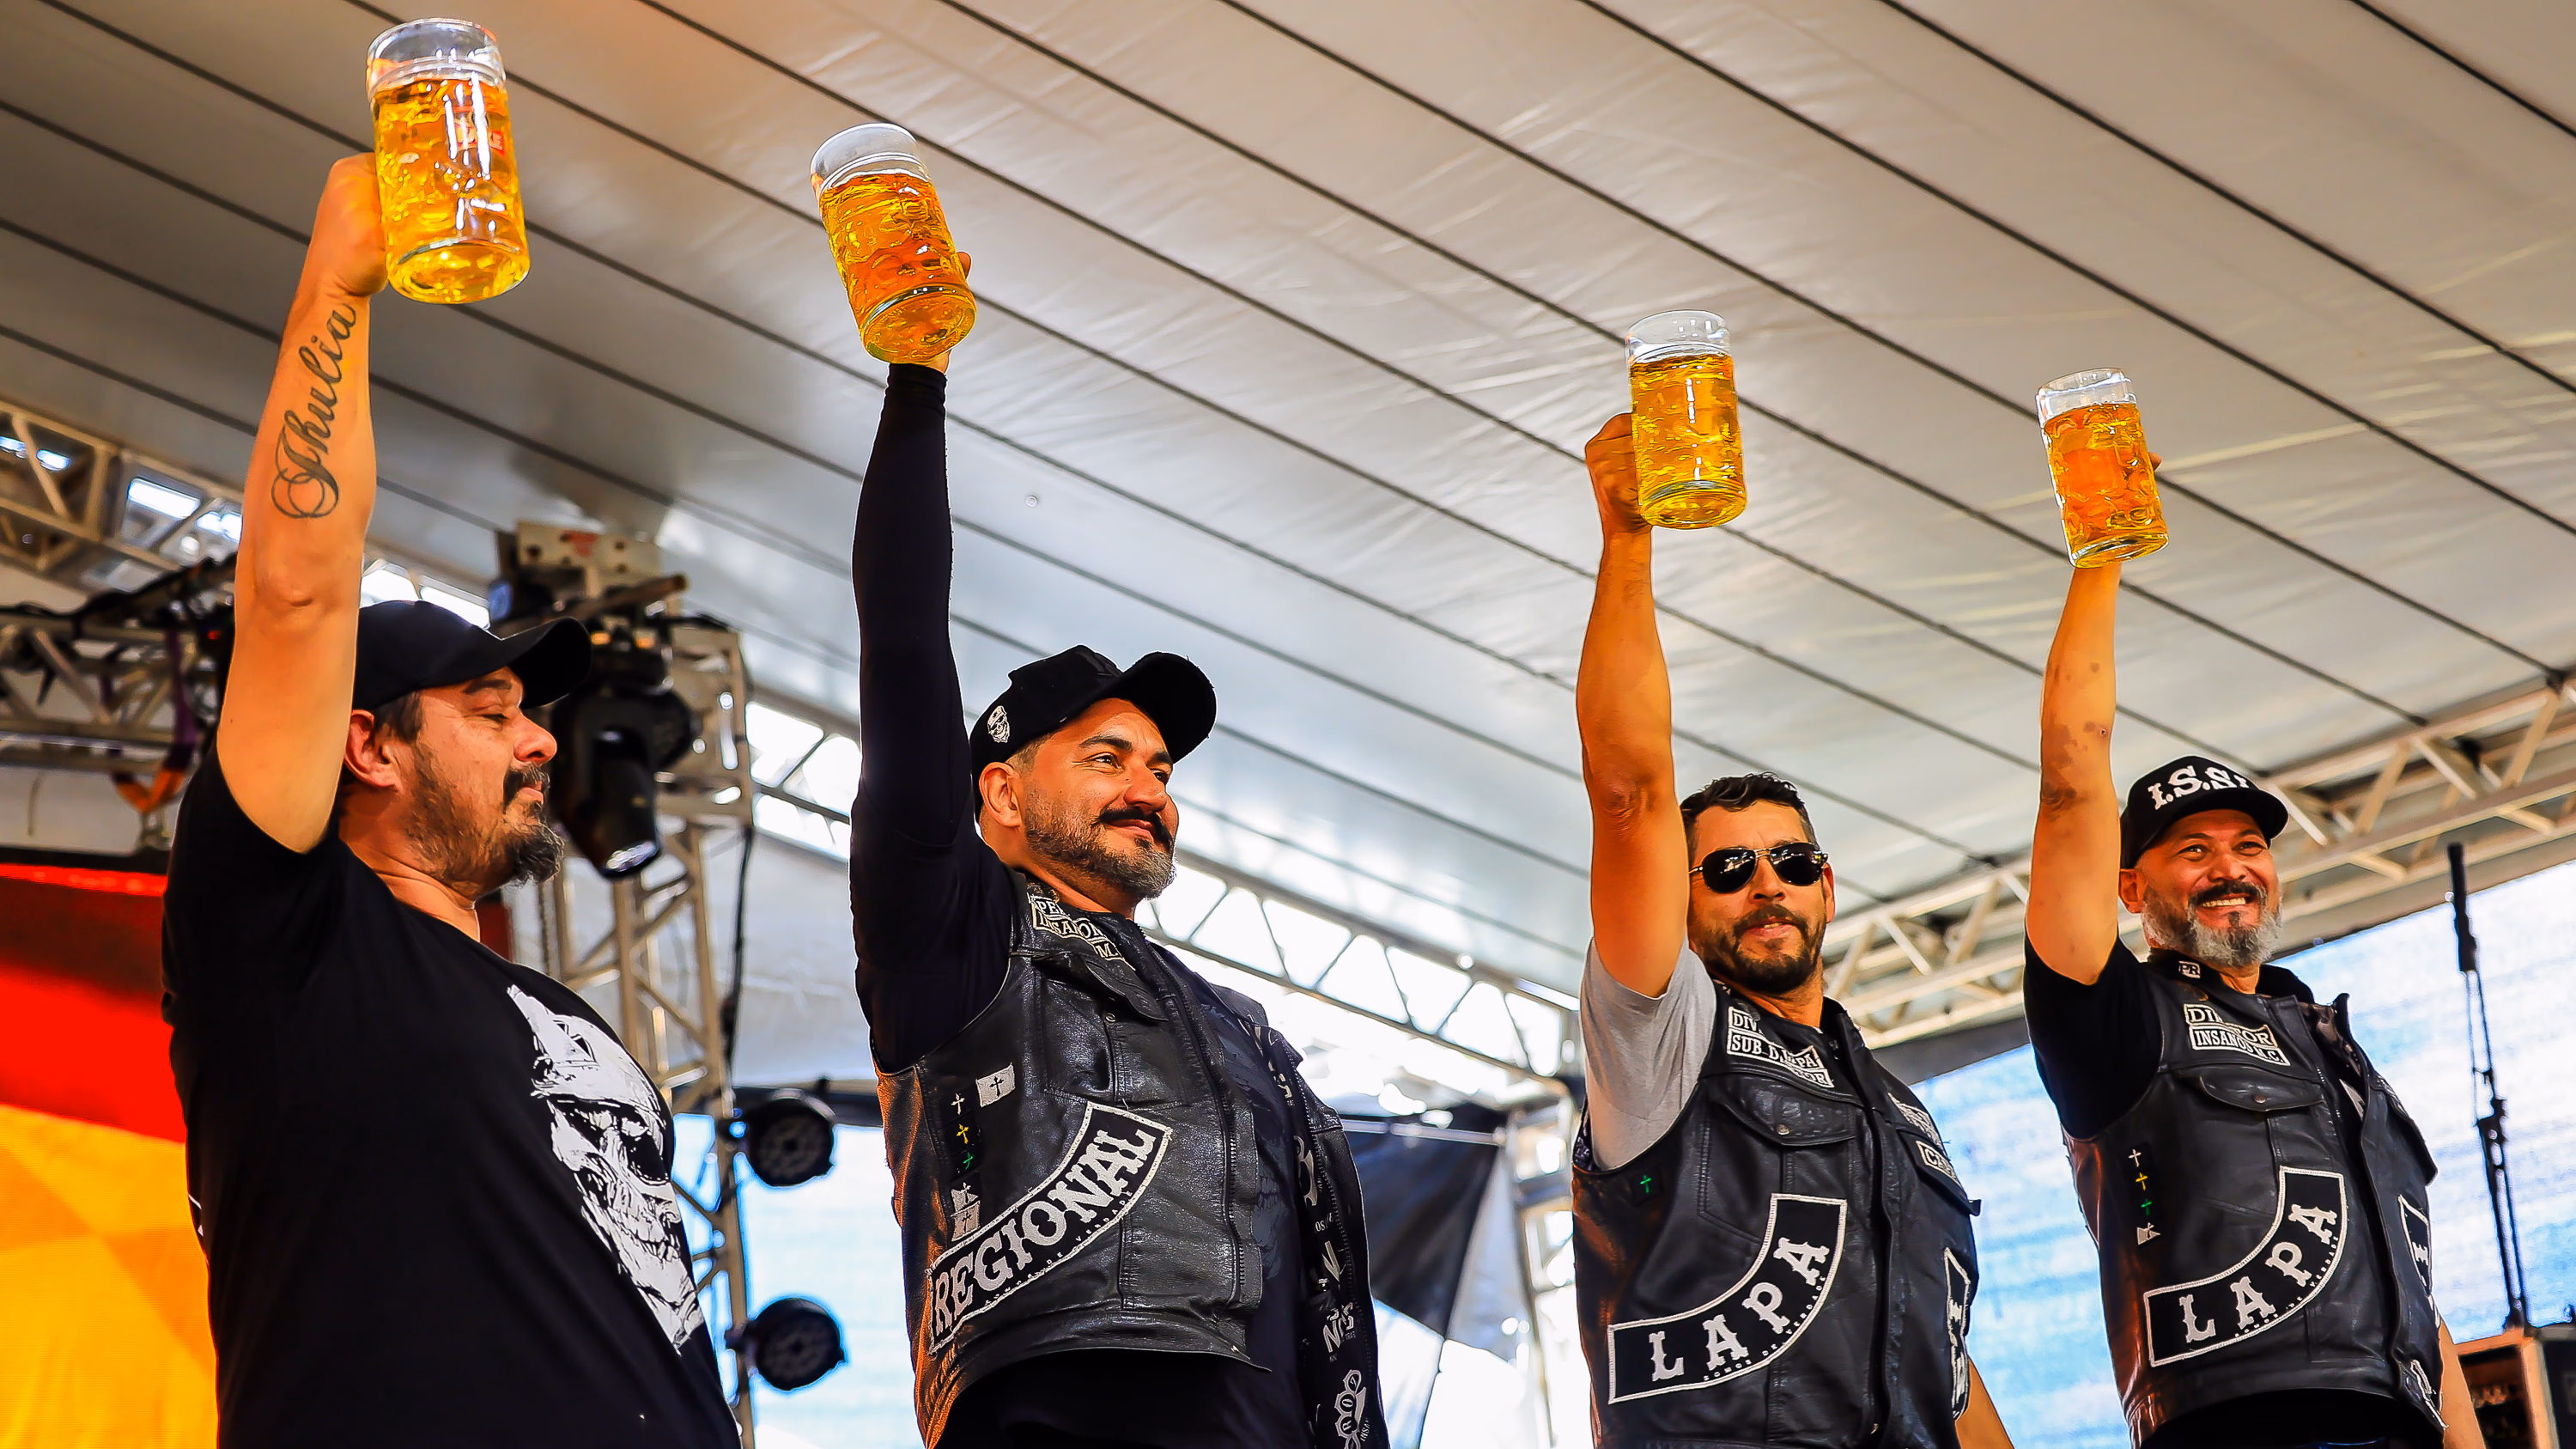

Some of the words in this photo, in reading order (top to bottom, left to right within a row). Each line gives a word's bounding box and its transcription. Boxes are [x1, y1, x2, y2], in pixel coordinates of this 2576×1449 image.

[935, 1129, 1157, 1336] REGIONAL
[2178, 1204, 2337, 1343] LAPA
[1649, 1237, 1830, 1381] LAPA
[1703, 1358, 1753, 1382] SOMOS
